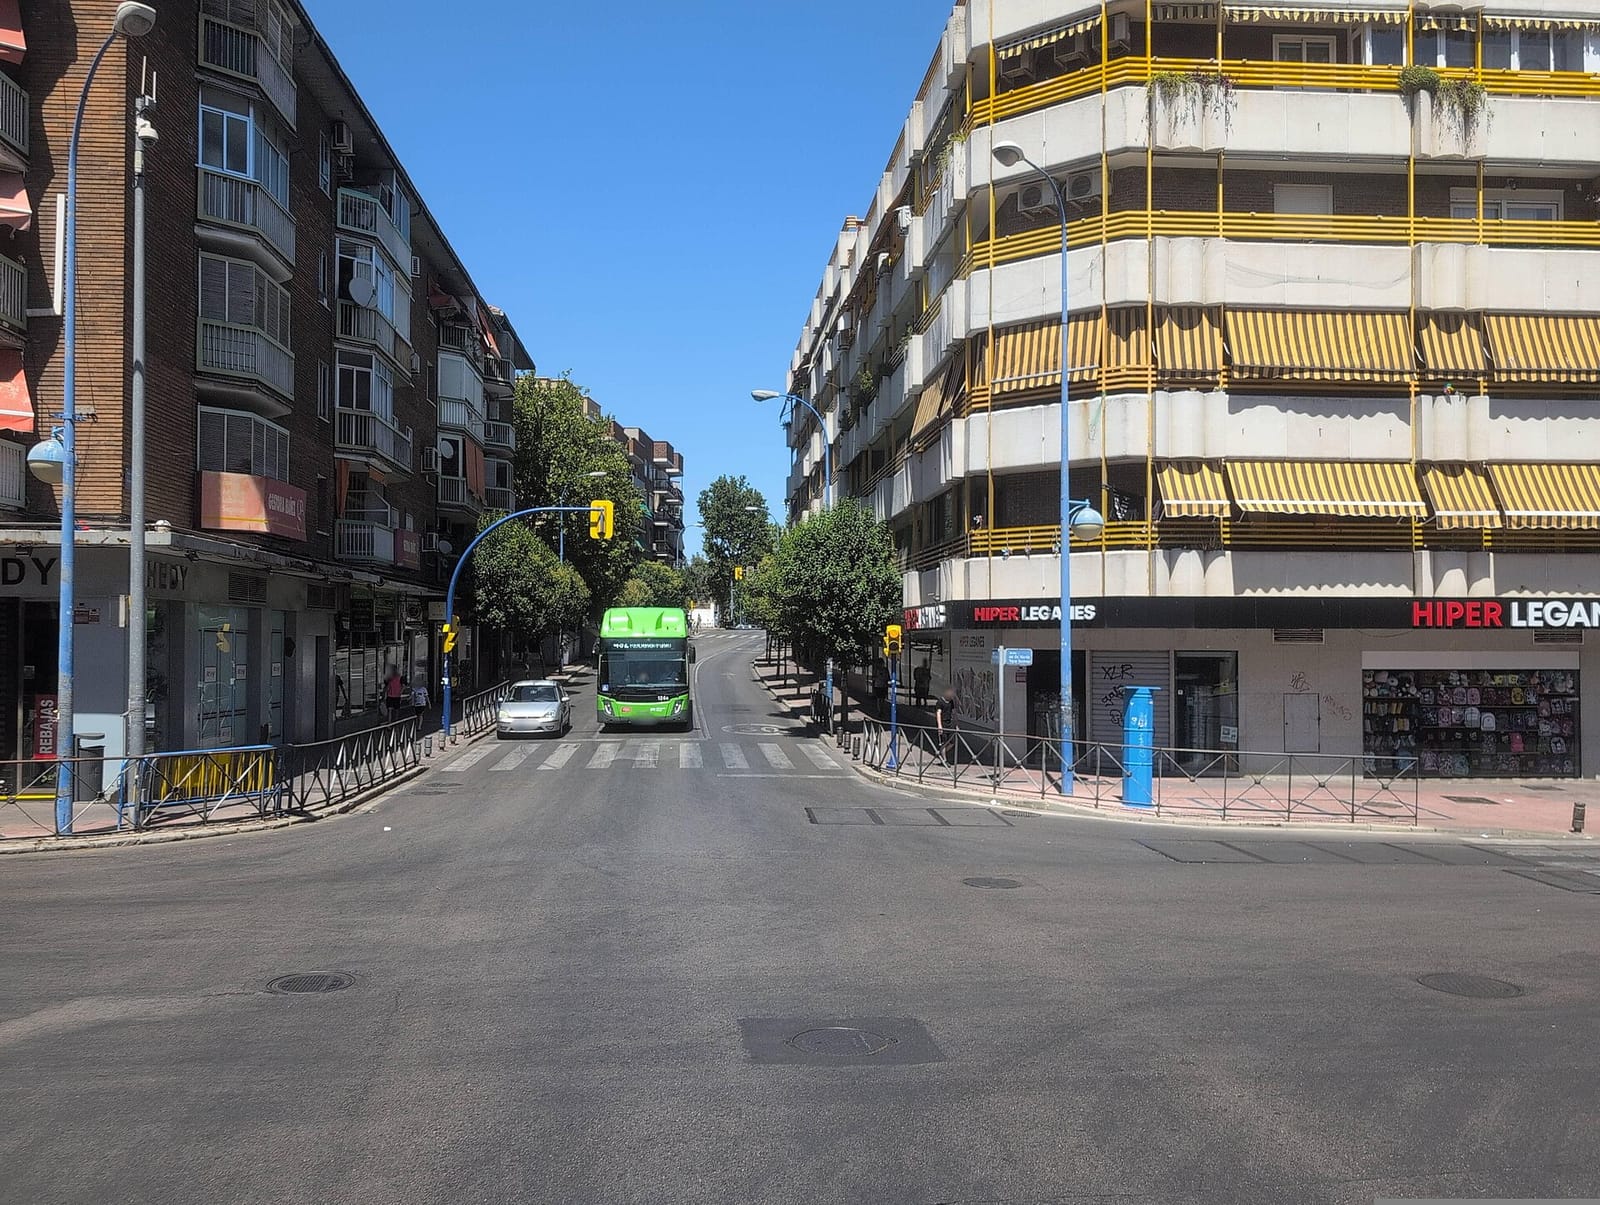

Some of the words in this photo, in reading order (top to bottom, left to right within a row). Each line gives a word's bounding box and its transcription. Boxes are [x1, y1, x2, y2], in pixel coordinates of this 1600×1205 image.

[974, 606, 1020, 622] HIPER
[1412, 600, 1503, 627] HIPER
[39, 699, 55, 754] REBAJAS
